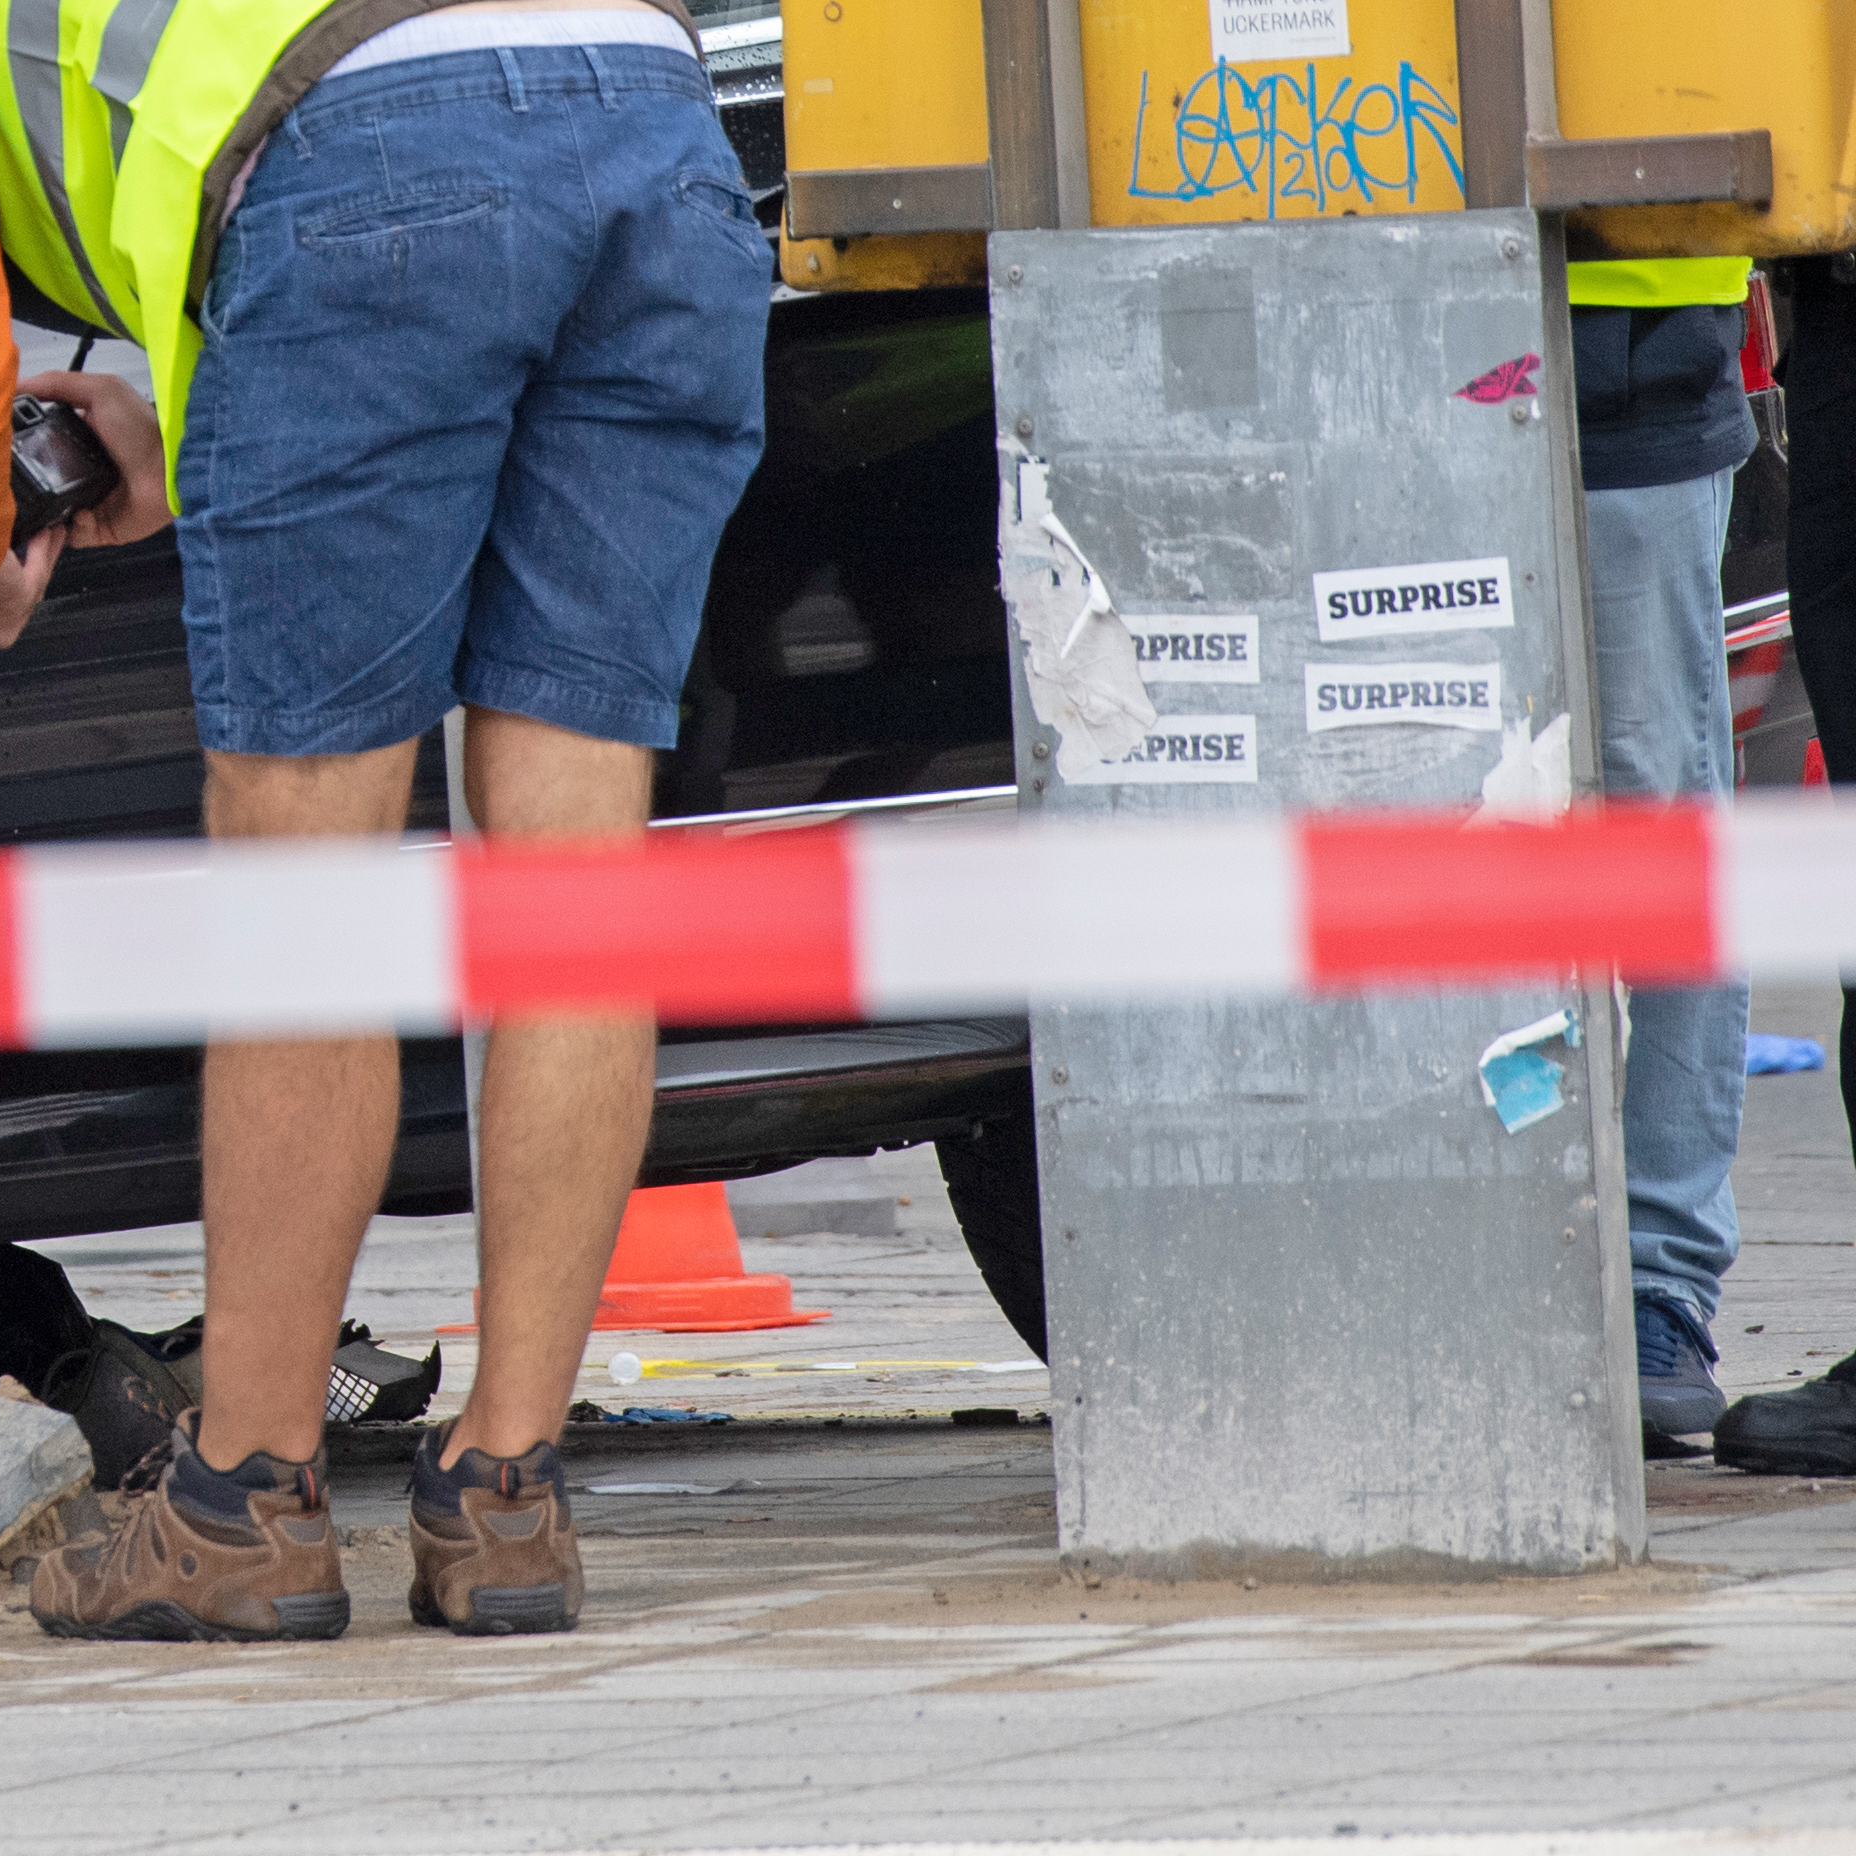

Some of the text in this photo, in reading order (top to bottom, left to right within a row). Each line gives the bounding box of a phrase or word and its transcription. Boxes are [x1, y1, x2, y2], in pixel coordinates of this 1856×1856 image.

[1223, 10, 1336, 34] UCKERMARK
[1327, 577, 1501, 620] SURPRISE
[1133, 633, 1248, 662] RPRISE
[1316, 681, 1489, 712] SURPRISE
